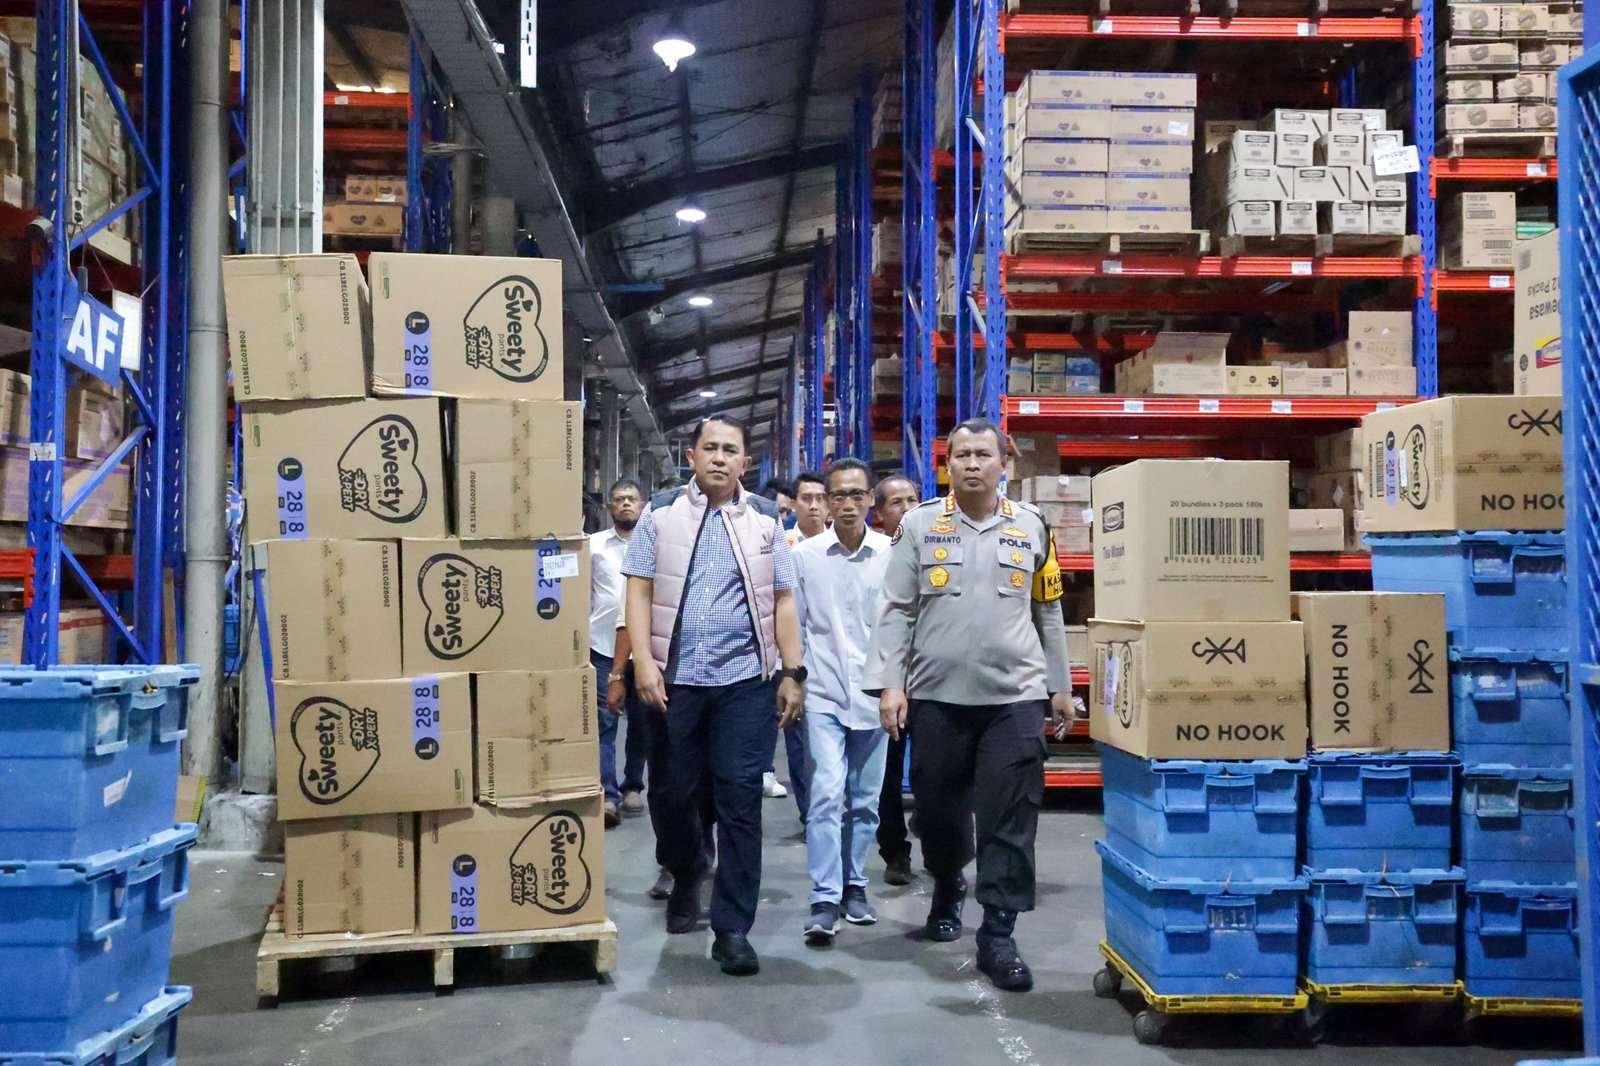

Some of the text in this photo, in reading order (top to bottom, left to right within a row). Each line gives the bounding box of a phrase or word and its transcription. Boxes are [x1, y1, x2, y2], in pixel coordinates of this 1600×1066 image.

[66, 300, 119, 370] AF
[412, 318, 426, 328] L
[501, 285, 526, 373] Sweety
[414, 344, 429, 386] 28 8
[479, 337, 492, 368] DRY
[284, 464, 298, 474] L
[378, 424, 404, 514] Sweety
[1412, 432, 1421, 502] Sweety
[354, 477, 369, 511] DRY
[373, 474, 382, 498] pants
[1481, 494, 1514, 511] NO
[286, 491, 304, 532] 28 8
[924, 535, 961, 544] DIRMANTO
[999, 538, 1031, 550] POLRI
[476, 568, 490, 599] DRY
[442, 564, 467, 650] Sweety
[540, 604, 554, 614] L
[1332, 624, 1350, 734] NO HOOK
[415, 687, 431, 728] 28 8
[351, 709, 365, 742] DRY
[1176, 724, 1285, 742] NO HOOK
[315, 707, 342, 796] Sweety
[418, 744, 433, 754] L
[460, 862, 472, 871] L
[545, 820, 569, 904] Sweety
[524, 872, 537, 904] DRY
[460, 886, 474, 928] 28 8
